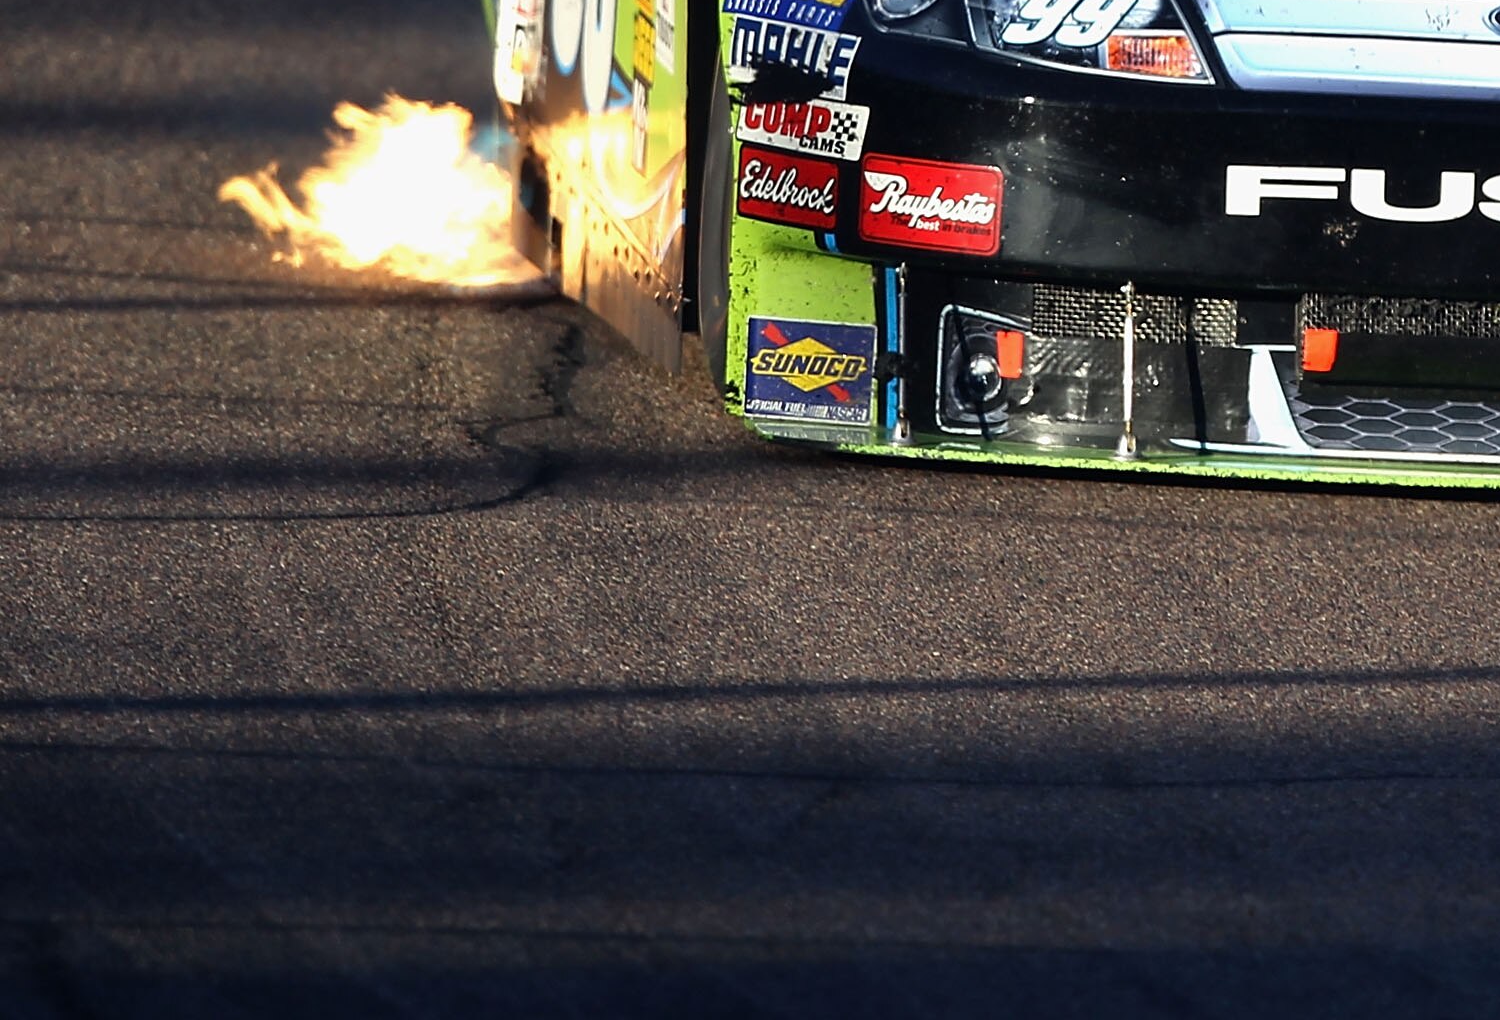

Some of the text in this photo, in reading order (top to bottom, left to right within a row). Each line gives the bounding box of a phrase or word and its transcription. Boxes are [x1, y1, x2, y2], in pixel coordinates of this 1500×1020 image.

[786, 2, 836, 28] PARTS
[744, 100, 832, 139] COMP
[800, 135, 847, 155] CAMS
[739, 160, 835, 215] Edelbrock
[864, 171, 997, 228] Raybestos
[916, 219, 941, 232] best
[755, 352, 863, 378] SUNOCO
